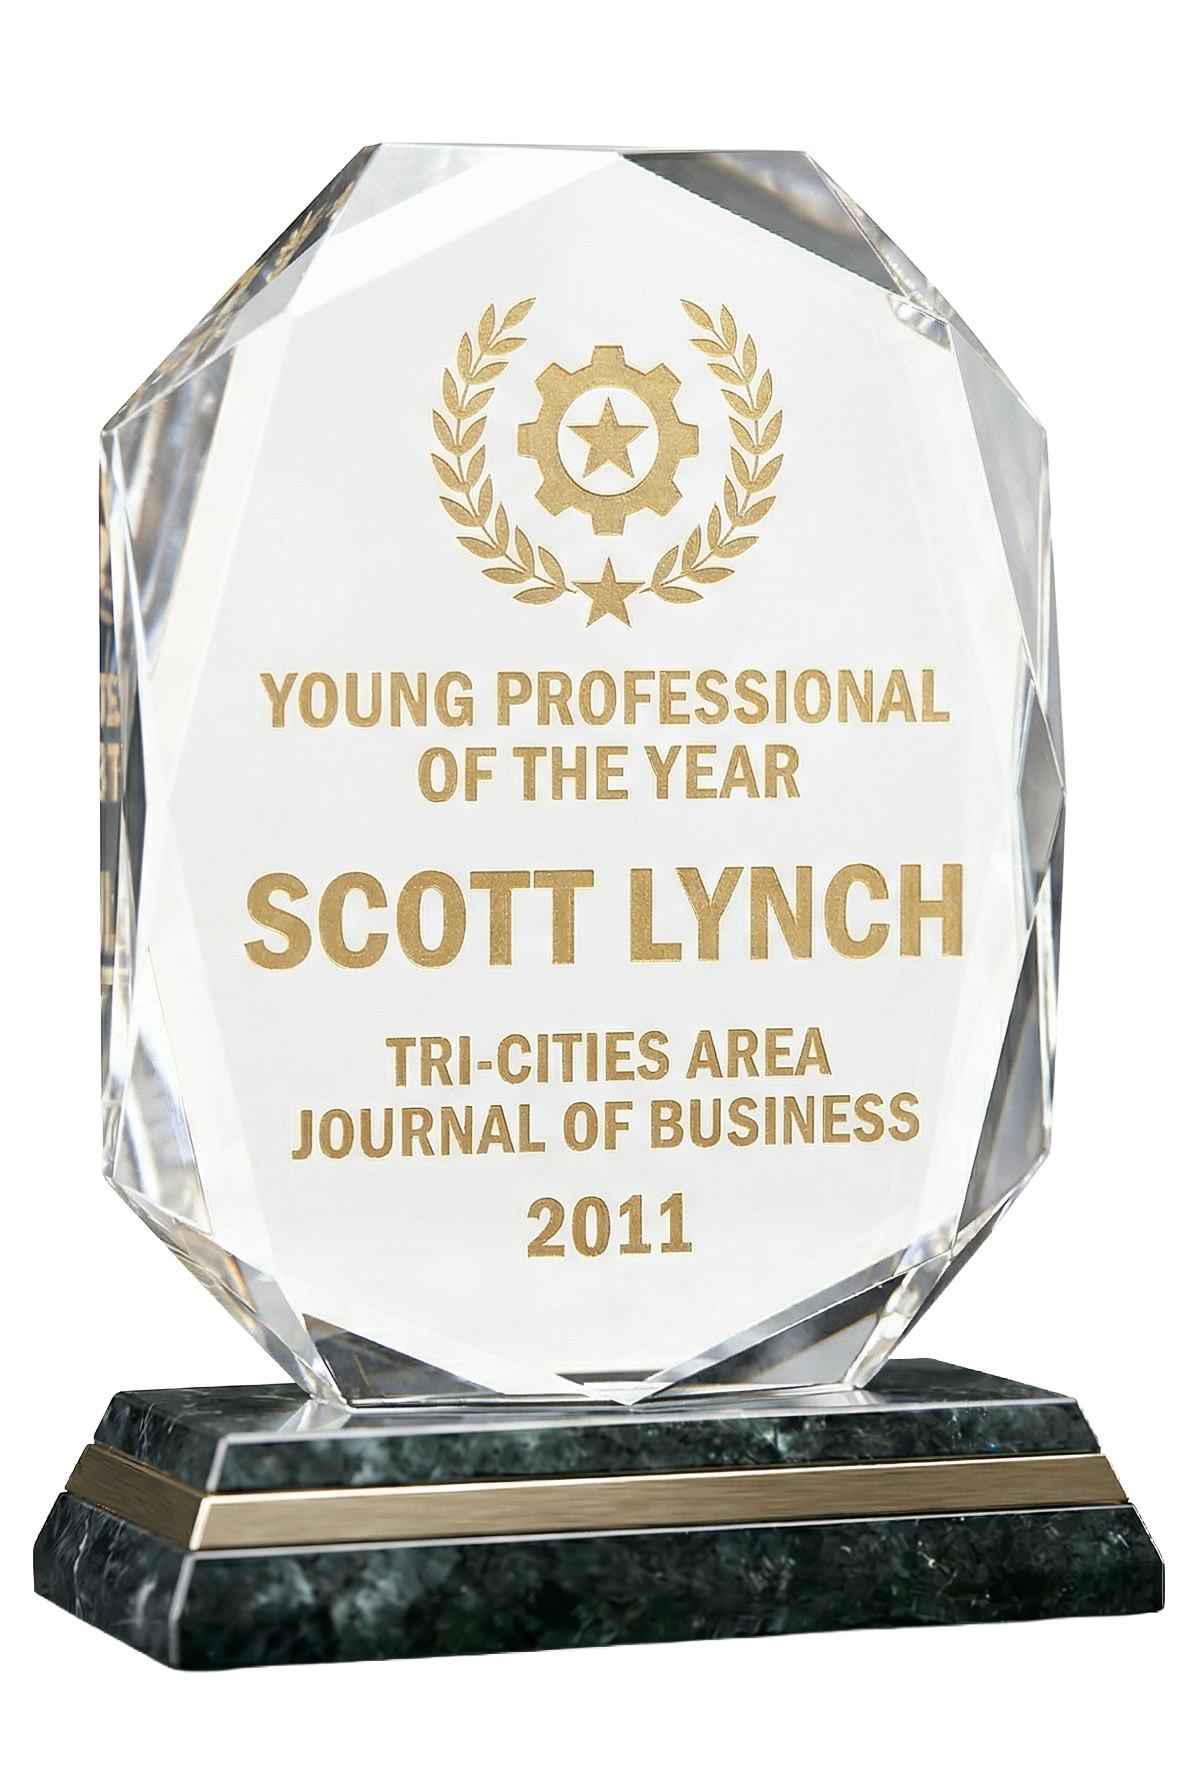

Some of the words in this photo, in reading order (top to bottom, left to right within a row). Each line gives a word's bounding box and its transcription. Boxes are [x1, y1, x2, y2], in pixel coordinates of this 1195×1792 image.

[260, 670, 474, 728] YOUNG
[496, 668, 949, 726] PROFESSIONAL
[418, 747, 496, 803] OF
[512, 745, 628, 801] THE
[645, 744, 800, 799] YEAR
[244, 870, 594, 971] SCOTT
[630, 862, 963, 963] LYNCH
[386, 1030, 669, 1087] TRI-CITIES
[686, 1028, 831, 1079] AREA
[292, 1104, 545, 1160] JOURNAL
[564, 1101, 633, 1151] OF
[651, 1092, 920, 1149] BUSINESS
[528, 1193, 691, 1258] 2011
